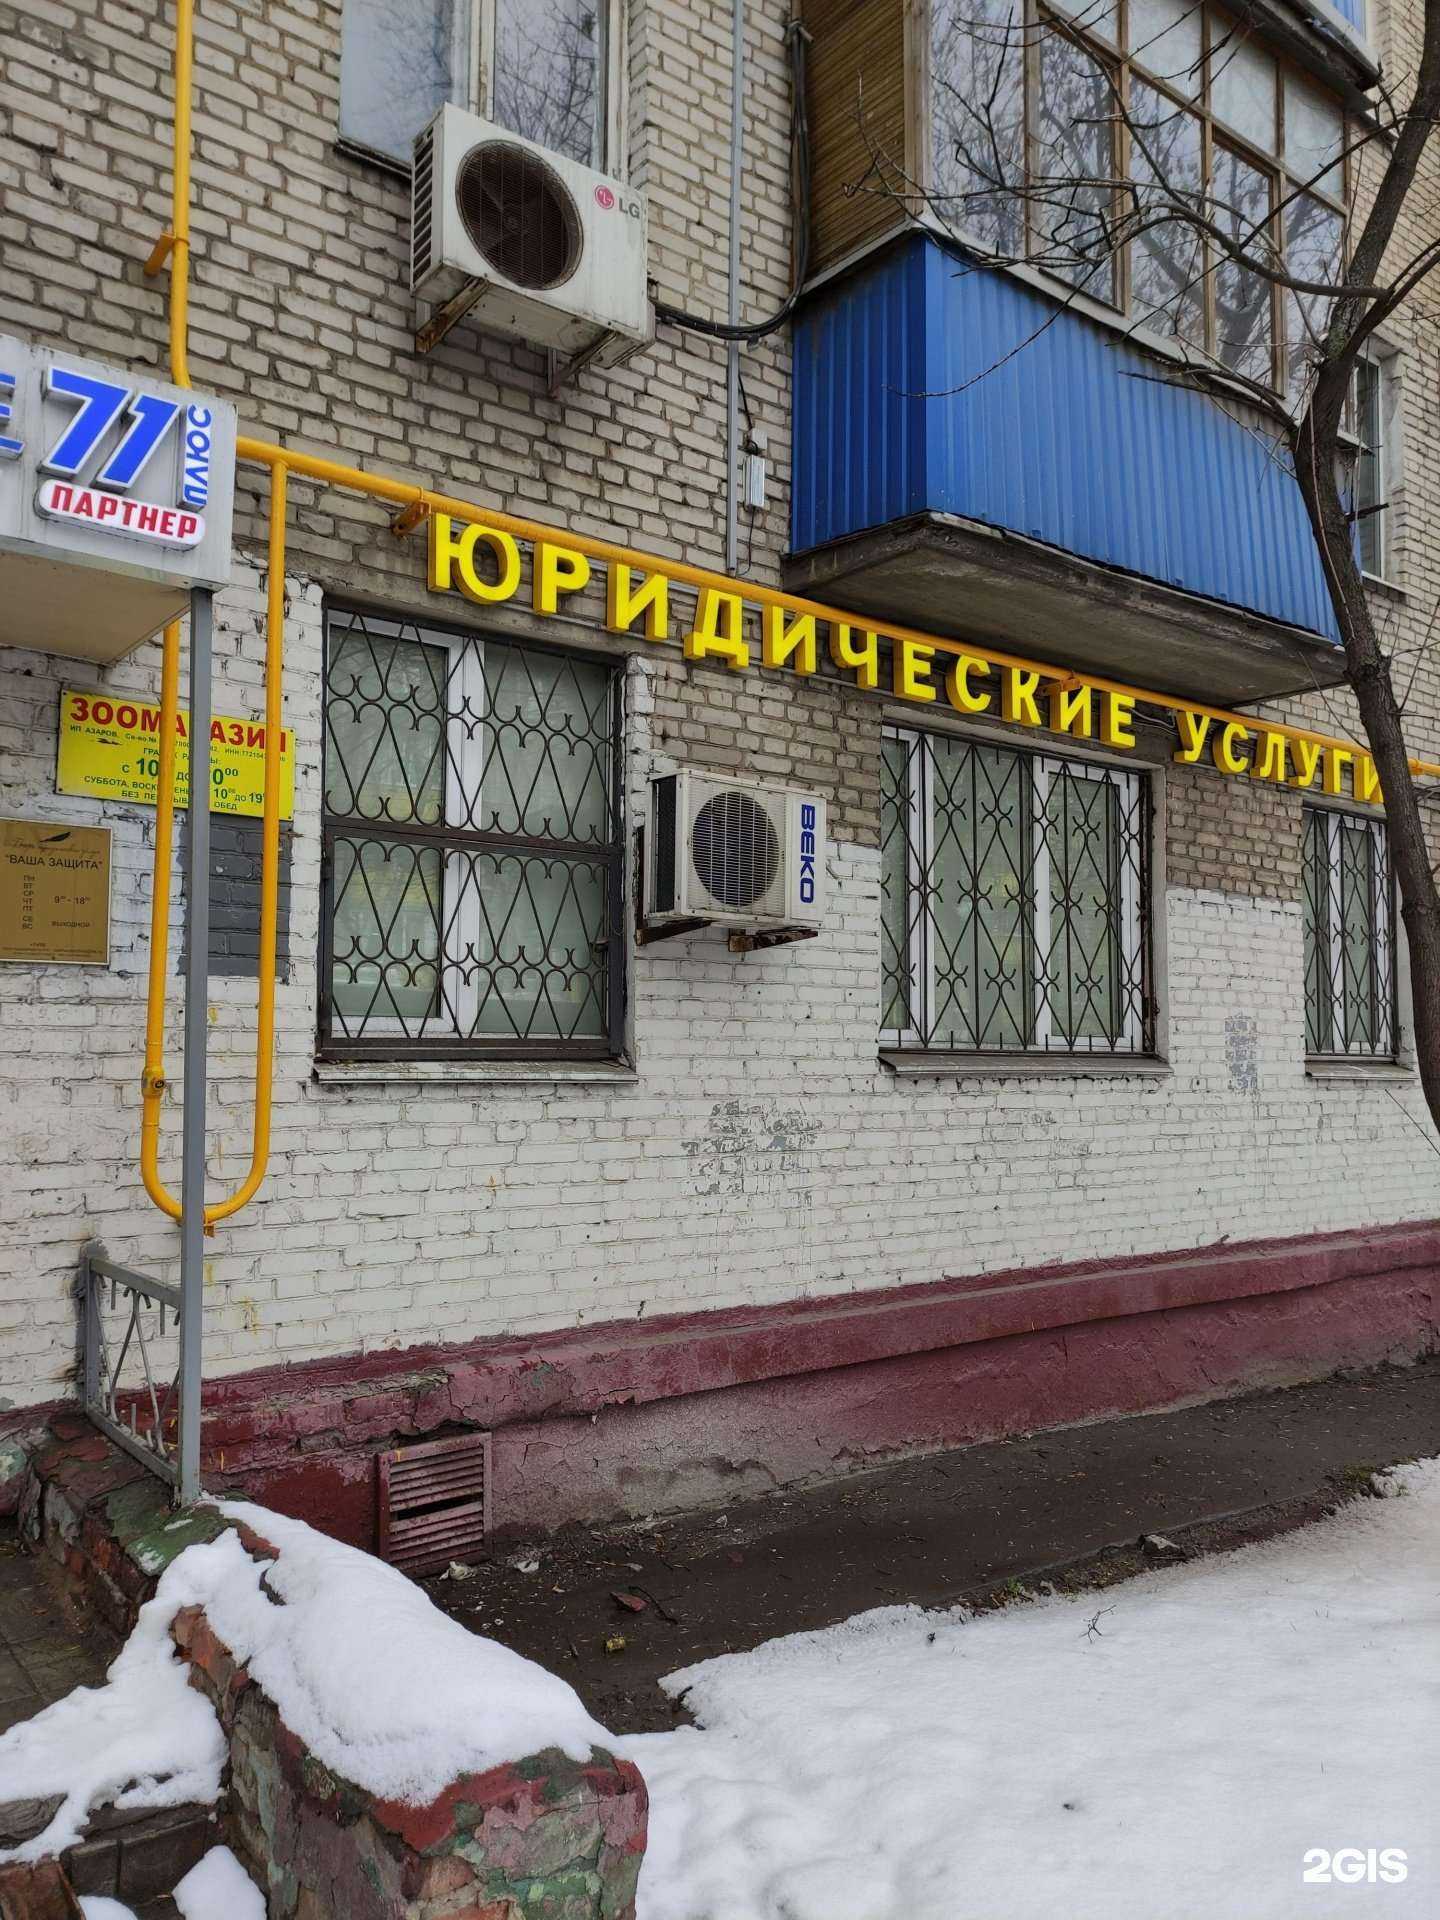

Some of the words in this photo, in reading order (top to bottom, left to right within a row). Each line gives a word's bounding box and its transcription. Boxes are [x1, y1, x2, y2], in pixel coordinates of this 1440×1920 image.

[619, 197, 640, 219] LG
[49, 365, 181, 487] 71
[183, 404, 212, 506] ПЛЮС
[50, 484, 198, 539] ПАРТНЕР
[428, 512, 1136, 748] ЮРИДИЧЕСКИЕ
[1174, 711, 1384, 804] УСЛУГИ
[70, 697, 286, 753] ЗООМААЗИ
[121, 790, 139, 799] БЕЗ
[214, 801, 237, 810] ОБЕД
[800, 804, 815, 904] BEKO
